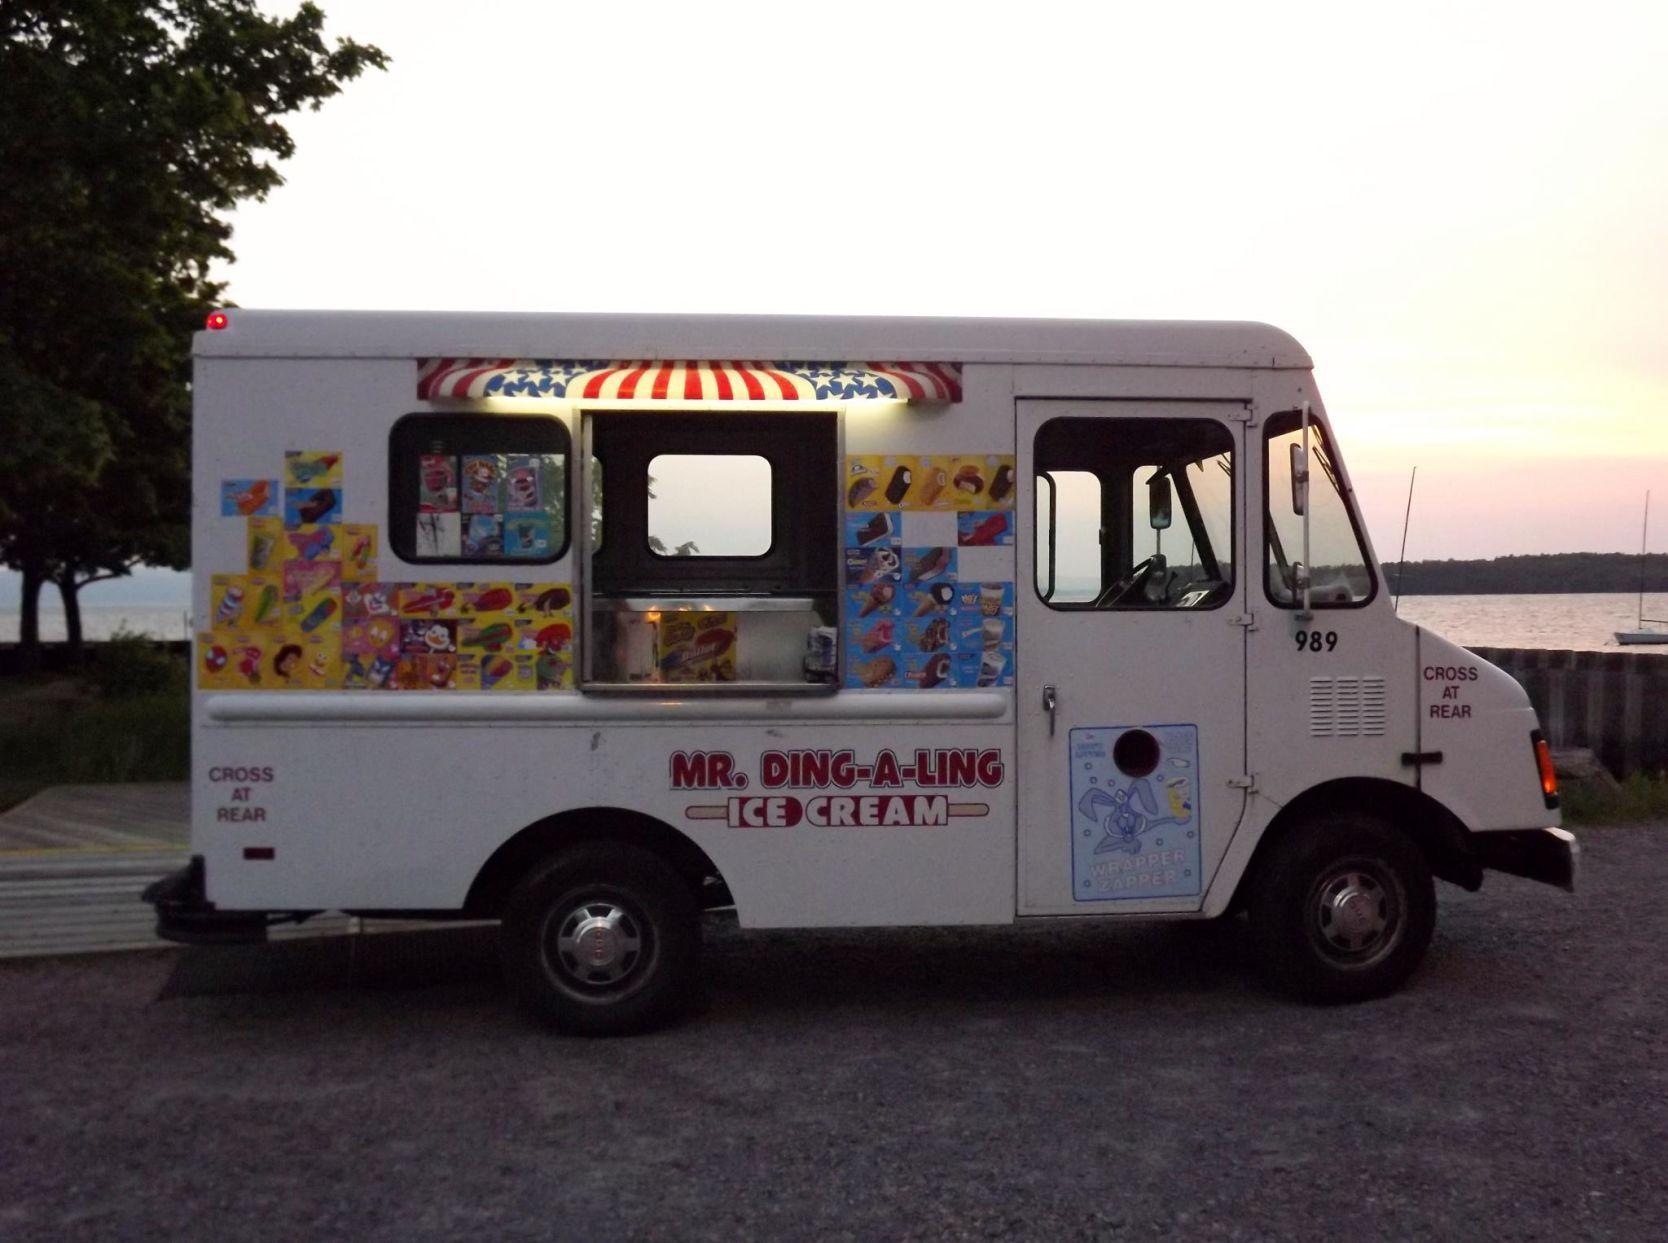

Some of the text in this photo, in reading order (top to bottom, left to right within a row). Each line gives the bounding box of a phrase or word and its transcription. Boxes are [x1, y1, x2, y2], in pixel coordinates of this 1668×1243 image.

[1295, 630, 1338, 652] 989
[1423, 666, 1479, 681] CROSS
[1441, 686, 1461, 699] AT
[1429, 704, 1472, 718] REAR
[208, 766, 275, 782] CROSS
[669, 748, 1004, 790] MR. DING-A-LING
[231, 786, 252, 802] AT
[216, 806, 267, 822] REAR
[729, 796, 948, 827] ICE CREAM
[1089, 849, 1186, 878] WRAPPER
[1099, 870, 1177, 893] ZAPPER
